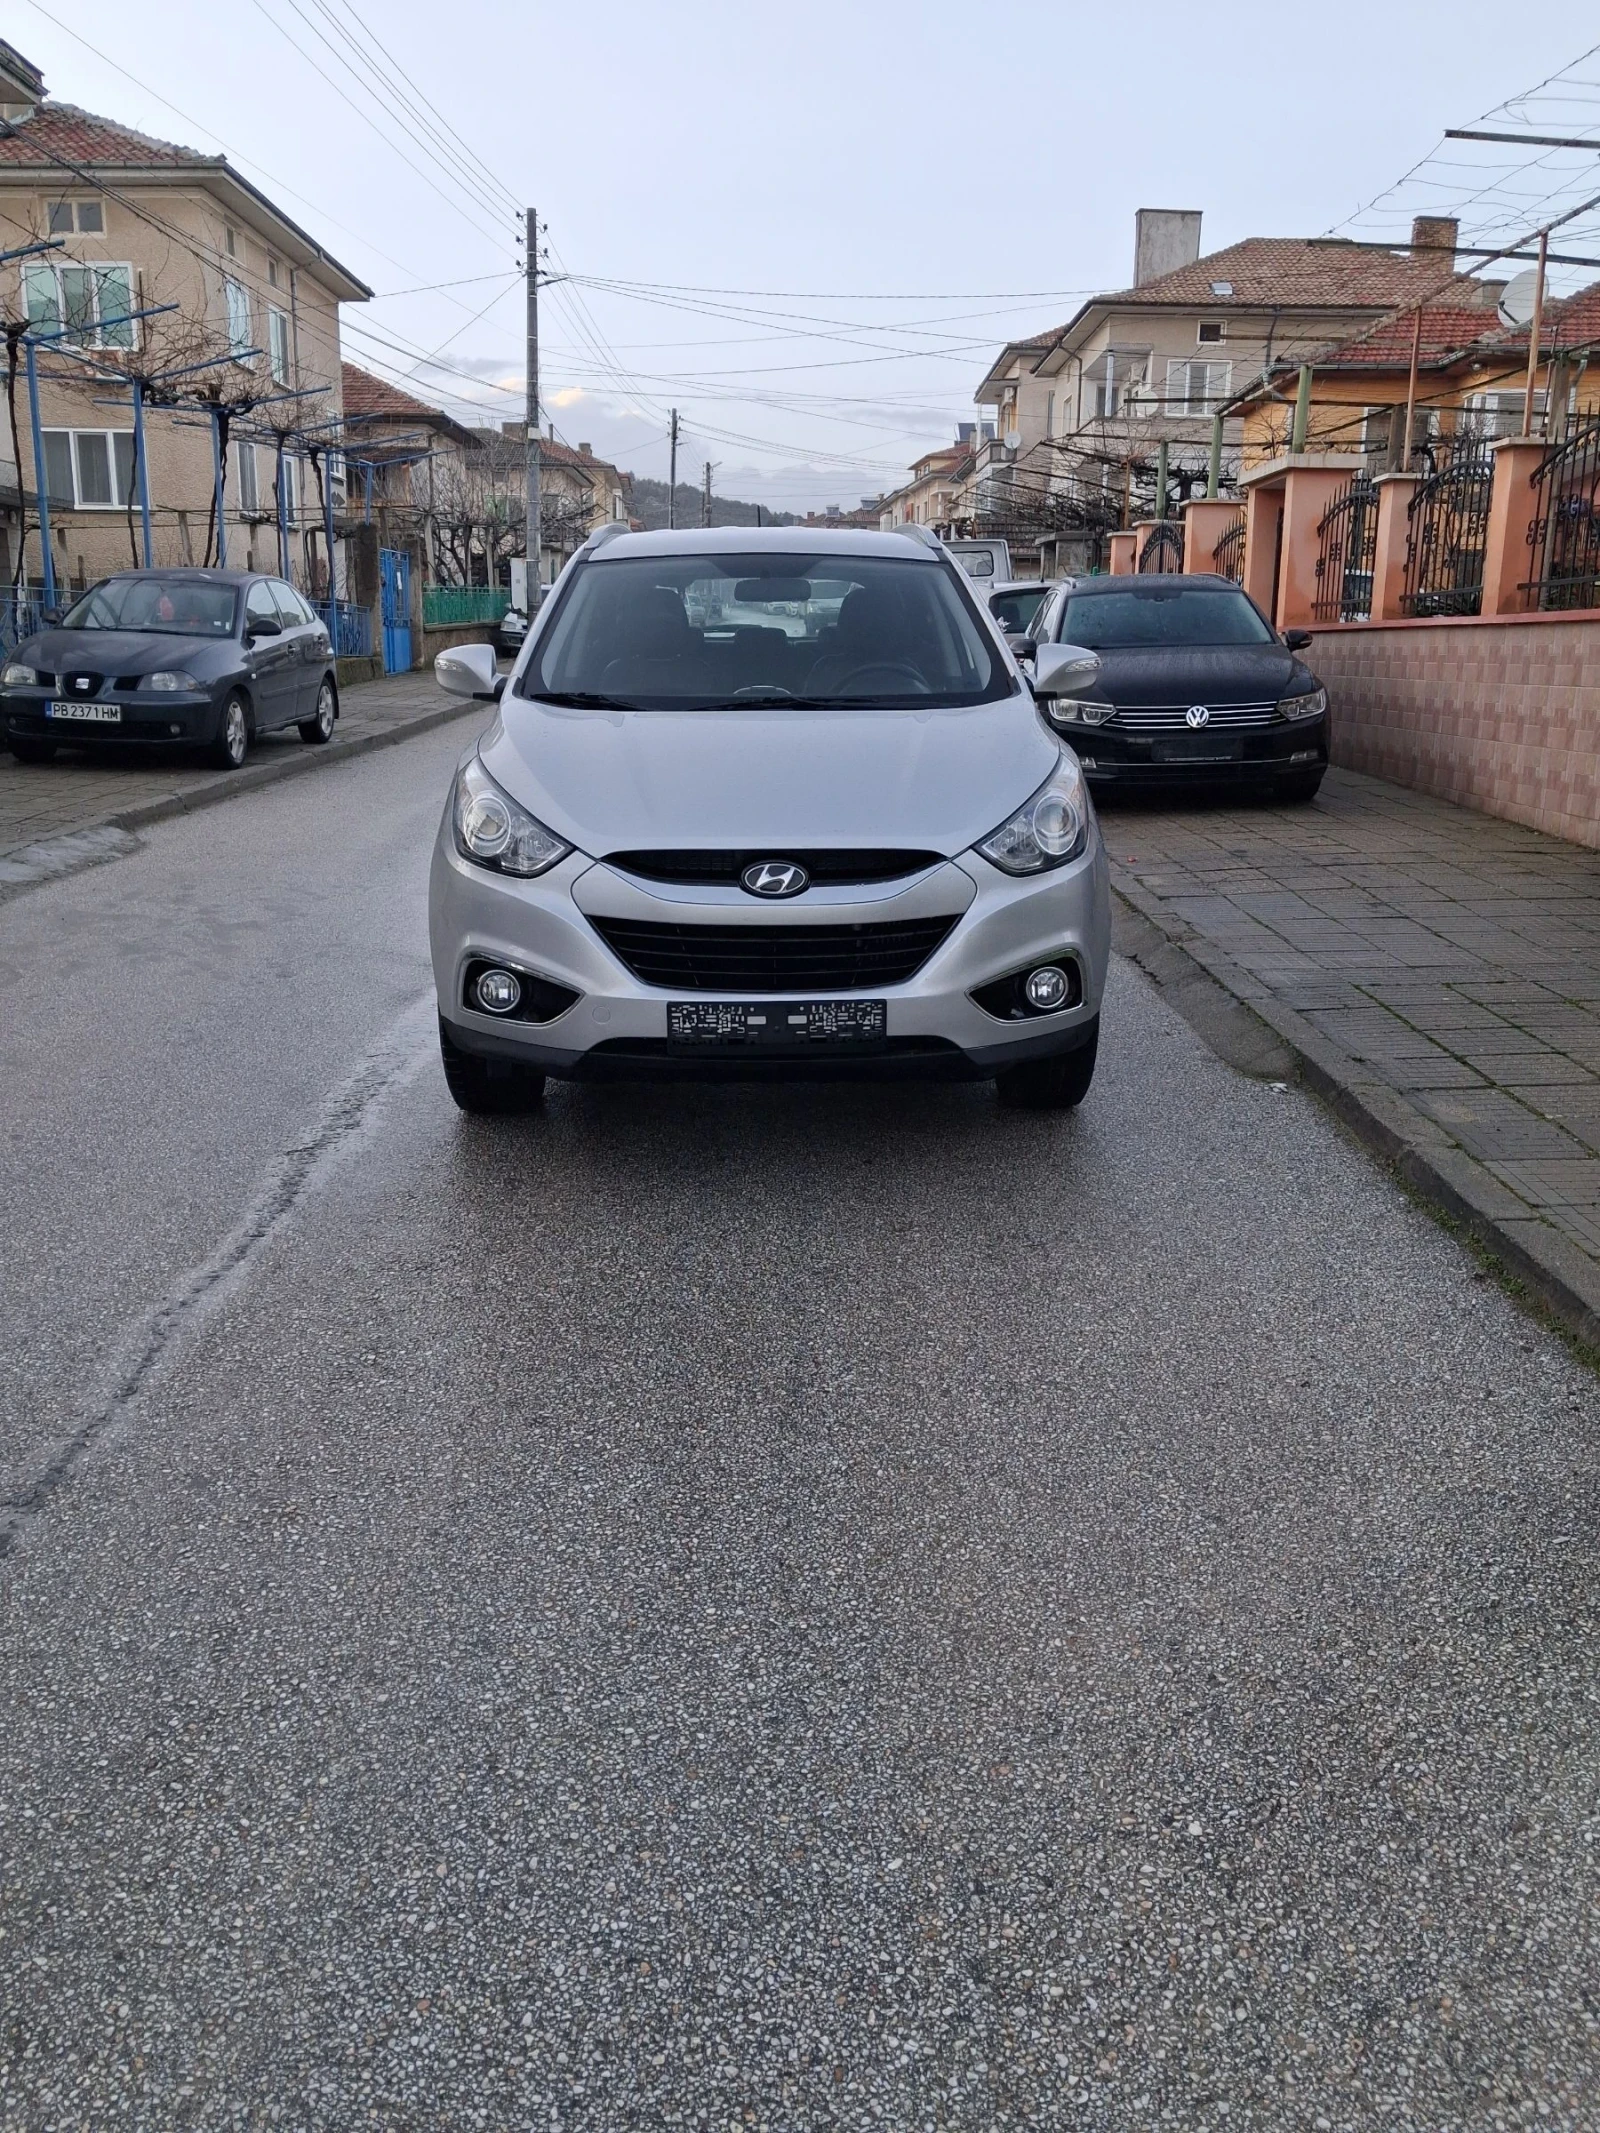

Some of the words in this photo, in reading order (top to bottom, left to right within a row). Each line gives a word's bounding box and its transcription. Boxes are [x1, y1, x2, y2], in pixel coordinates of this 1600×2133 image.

[53, 704, 69, 717] PB
[71, 705, 99, 719] 2371
[101, 706, 119, 720] HM
